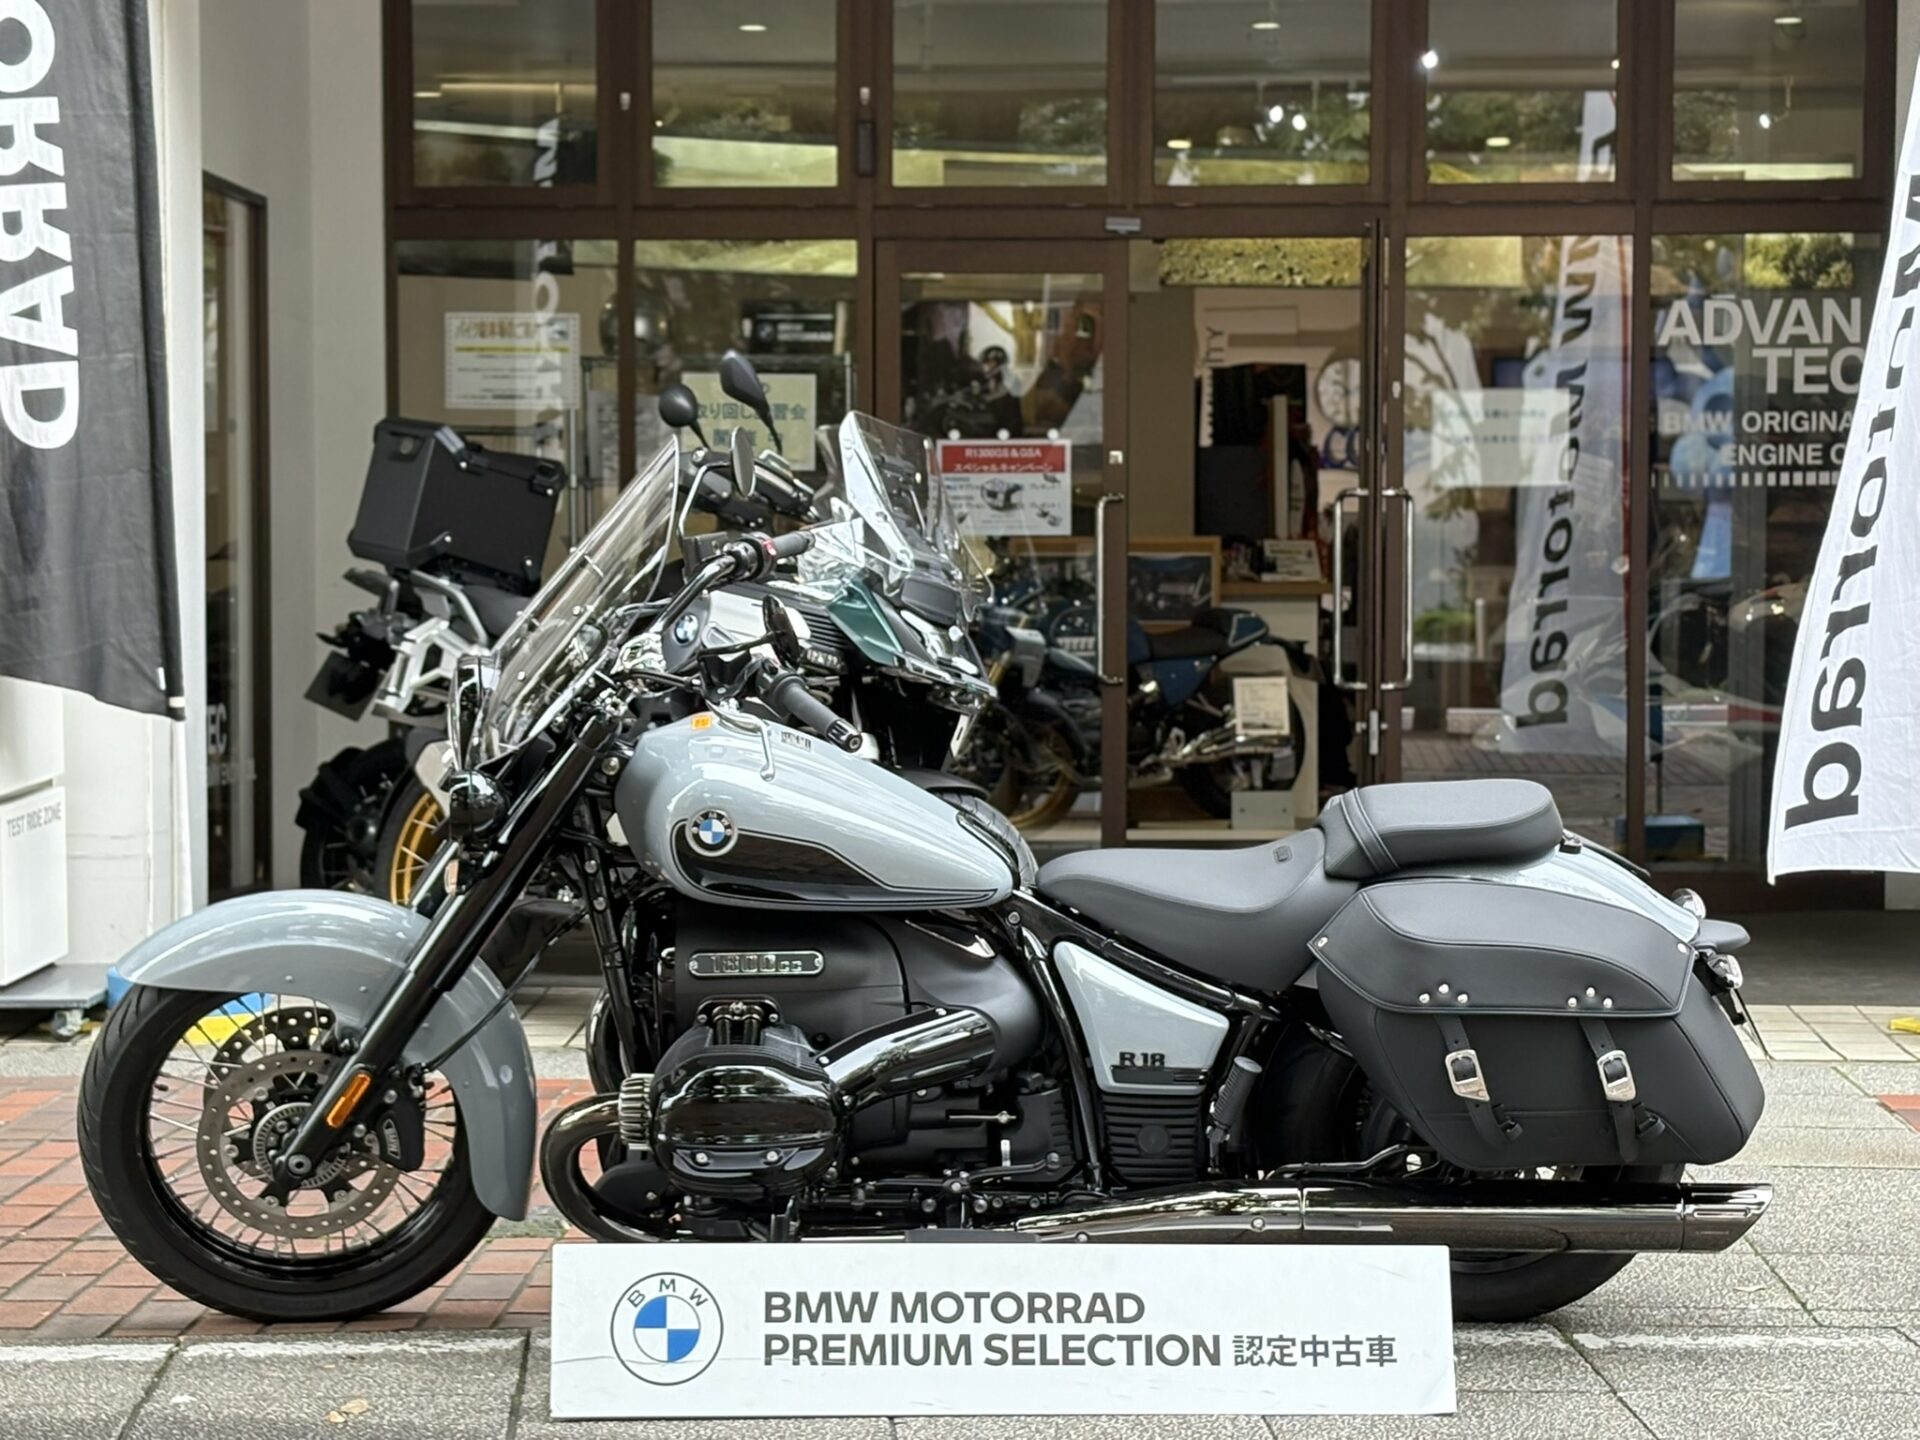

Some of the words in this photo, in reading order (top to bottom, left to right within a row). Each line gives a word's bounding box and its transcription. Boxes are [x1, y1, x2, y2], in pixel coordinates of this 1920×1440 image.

[1657, 297, 1861, 346] ADVAN
[1661, 411, 1732, 434] BMW
[1720, 443, 1824, 466] ENGINE
[6, 814, 25, 838] TEST
[26, 808, 43, 832] RIDE
[43, 802, 62, 825] ZONE
[710, 954, 803, 974] 1800cc
[626, 1277, 709, 1309] BMW
[764, 1292, 879, 1324] BMW
[890, 1291, 1145, 1324] MOTORRAD
[764, 1333, 971, 1367] PREMIUM
[983, 1333, 1221, 1367] SELECTION
[1233, 1334, 1398, 1368] 認定中古車
